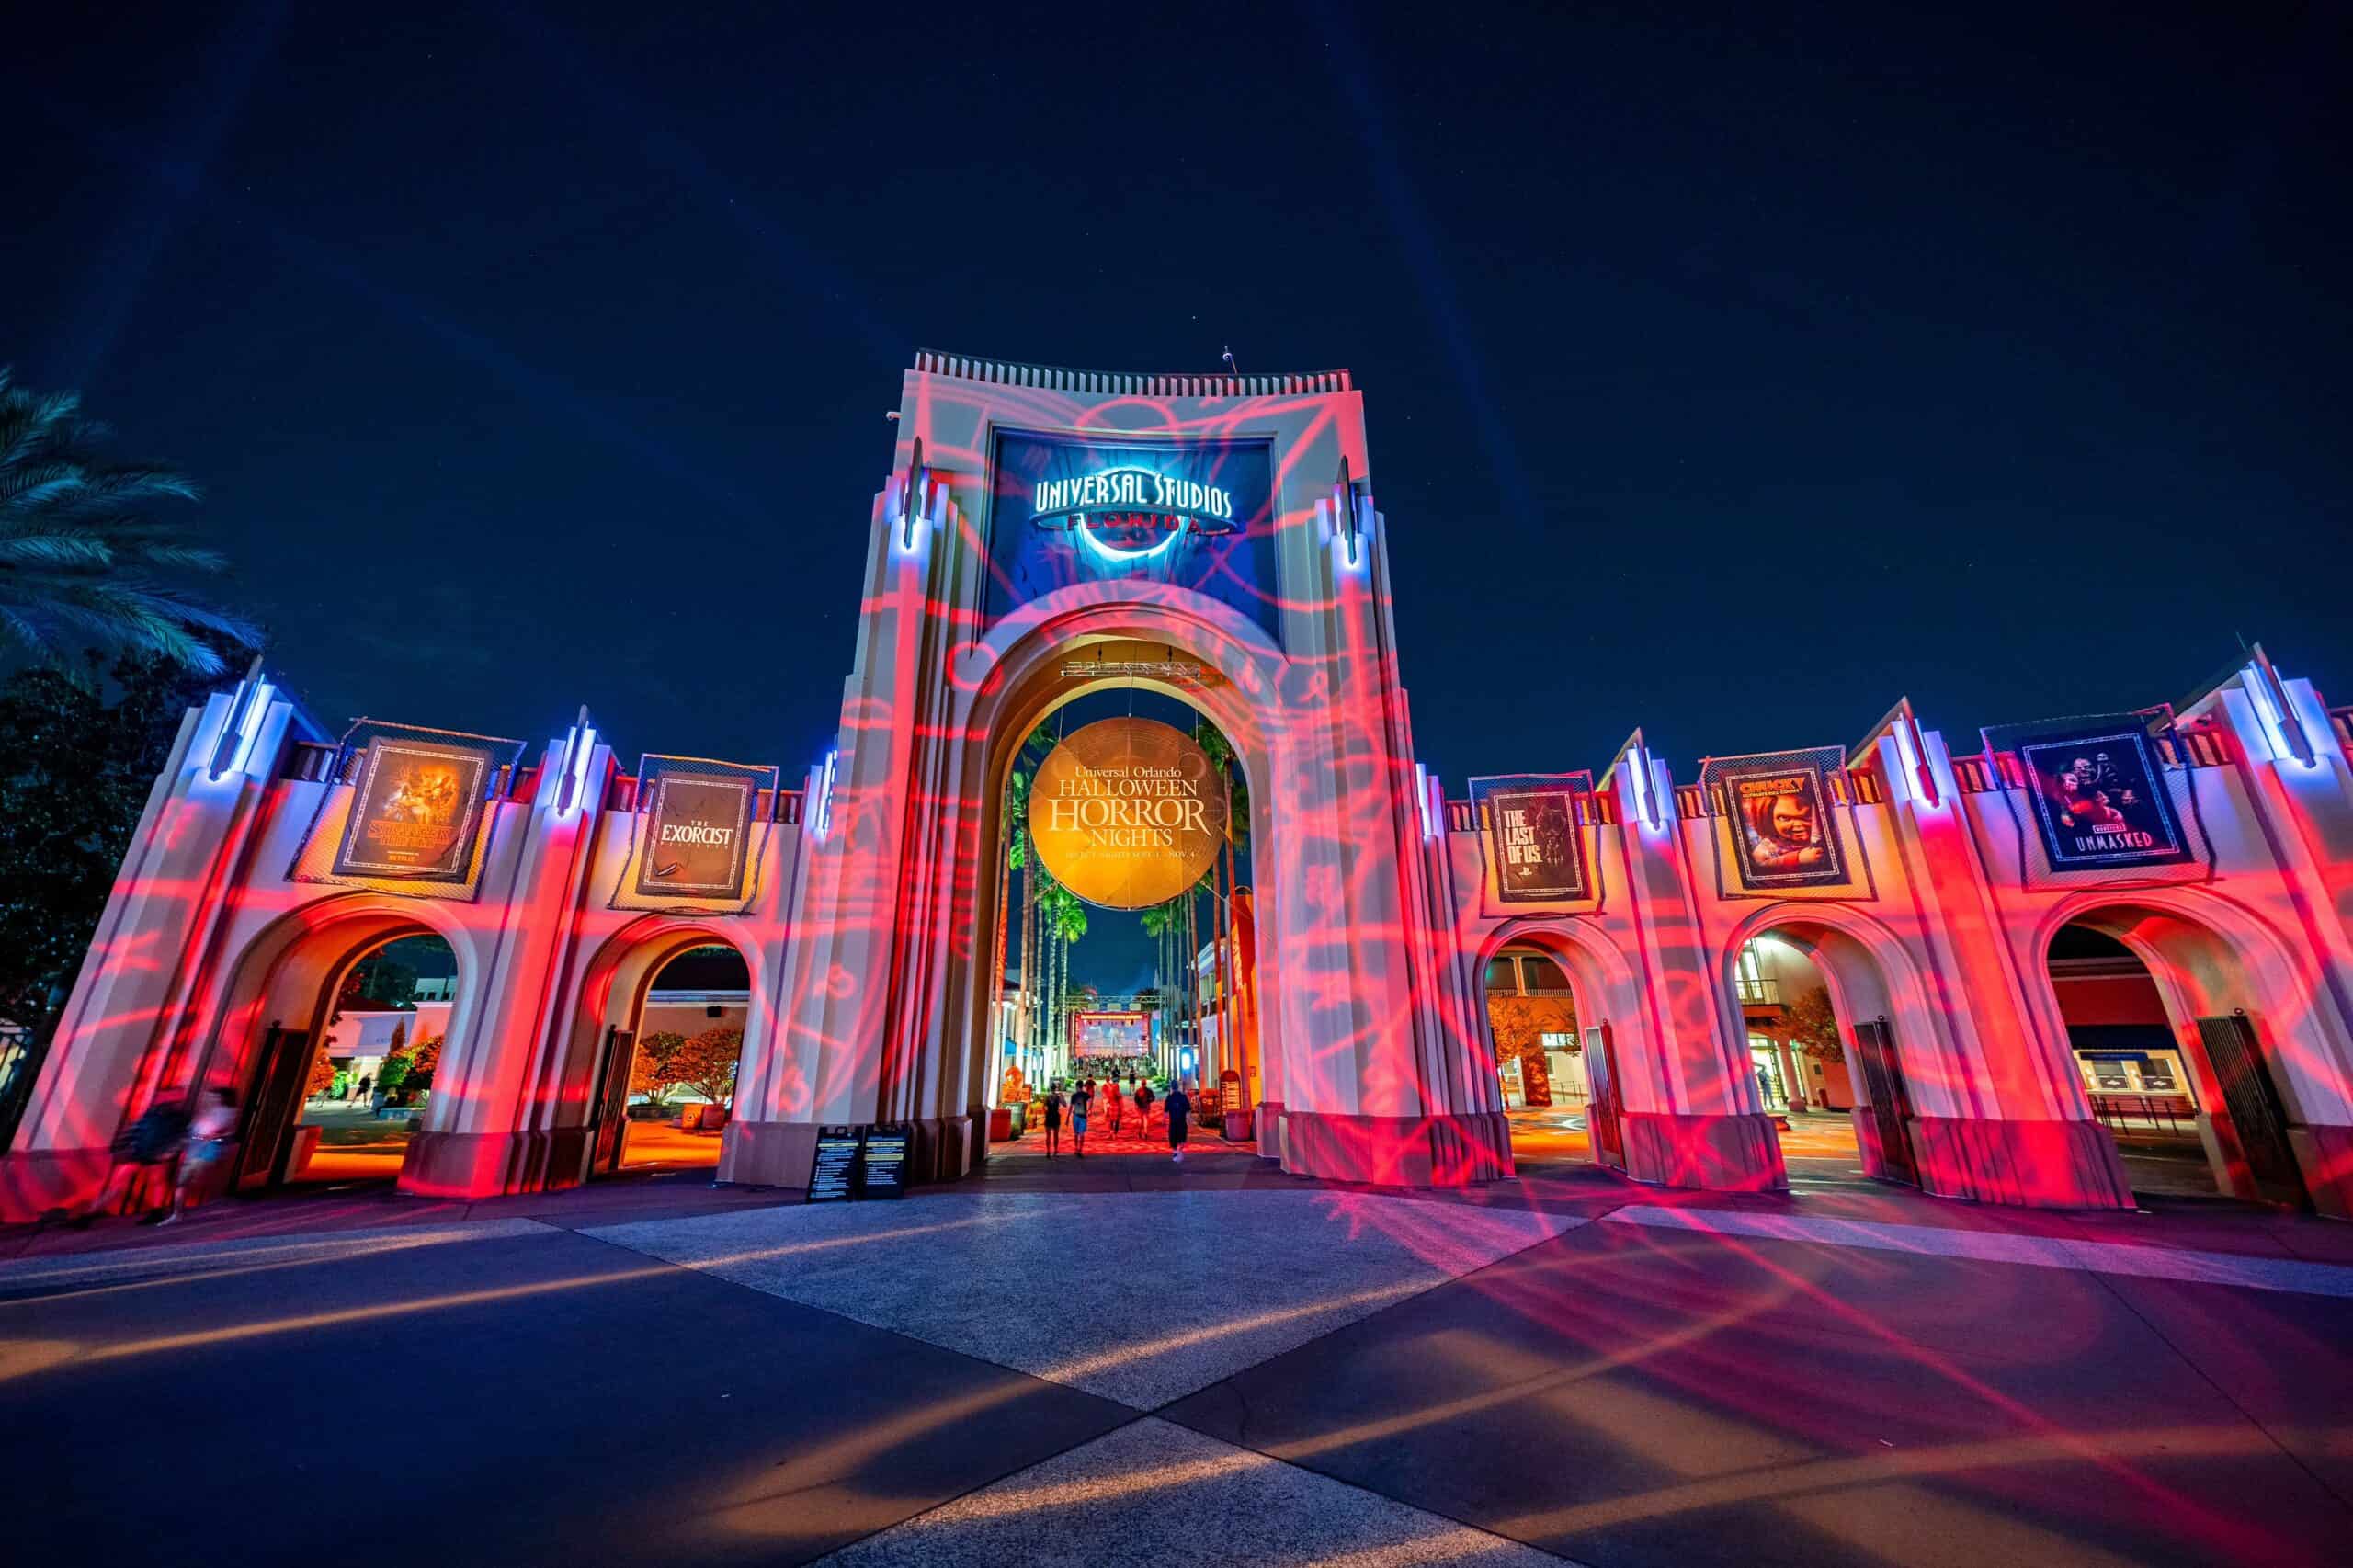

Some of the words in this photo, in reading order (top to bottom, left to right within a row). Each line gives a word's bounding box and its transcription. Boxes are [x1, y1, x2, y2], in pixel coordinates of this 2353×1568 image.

[1036, 473, 1148, 513] UNIVERSAL
[1154, 473, 1233, 519] STUDIOS
[1067, 512, 1203, 533] FLORIDA
[1074, 766, 1129, 778] Universal
[1134, 766, 1182, 778] Orlando
[1059, 779, 1199, 797] HALLOWEEN
[1739, 778, 1806, 793] CHUCKY
[1048, 799, 1212, 837] HORROR
[1503, 809, 1527, 827] THE
[661, 824, 734, 845] EXORCIST
[1091, 829, 1173, 846] NIGHTS
[1505, 826, 1535, 846] LAST
[2075, 832, 2153, 852] UNMASKED
[1506, 846, 1522, 864] OF
[1523, 845, 1540, 863] US
